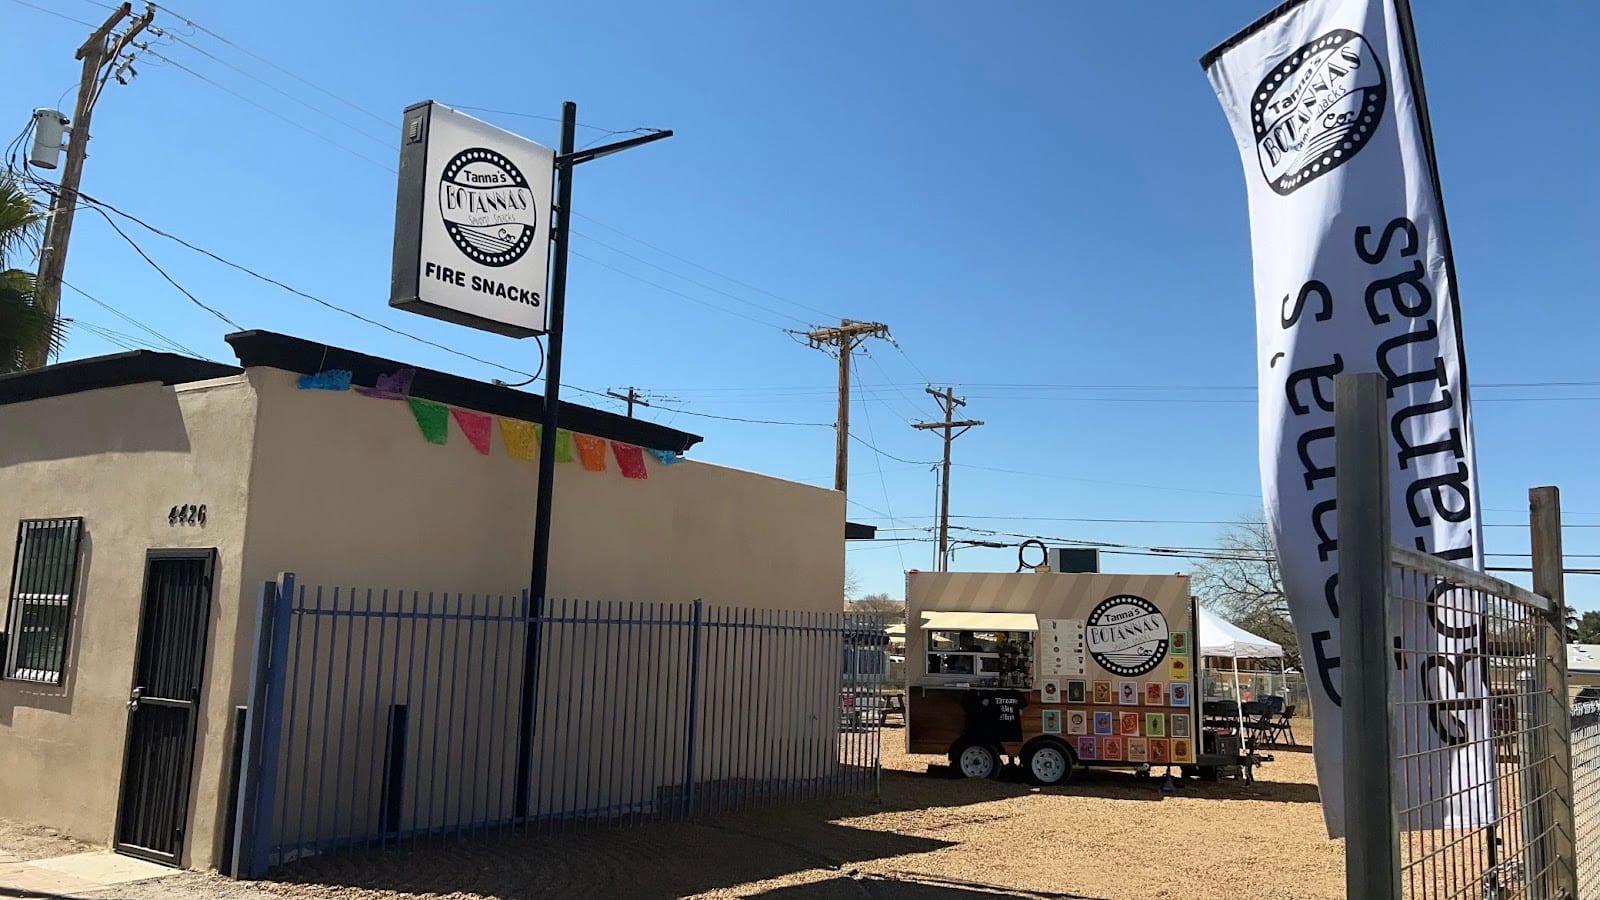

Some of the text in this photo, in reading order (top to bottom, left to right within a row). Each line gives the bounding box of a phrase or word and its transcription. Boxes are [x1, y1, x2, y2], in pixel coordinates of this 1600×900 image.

[1268, 57, 1321, 114] Tanna's
[1316, 84, 1347, 114] nacks
[1263, 46, 1360, 167] BOTANNAS
[463, 169, 507, 184] Tanna's
[446, 185, 527, 213] BOTANNAS
[425, 262, 541, 308] FIRE SNACKS
[1091, 615, 1160, 645] BOTANNAS
[1104, 608, 1141, 623] Tanna's
